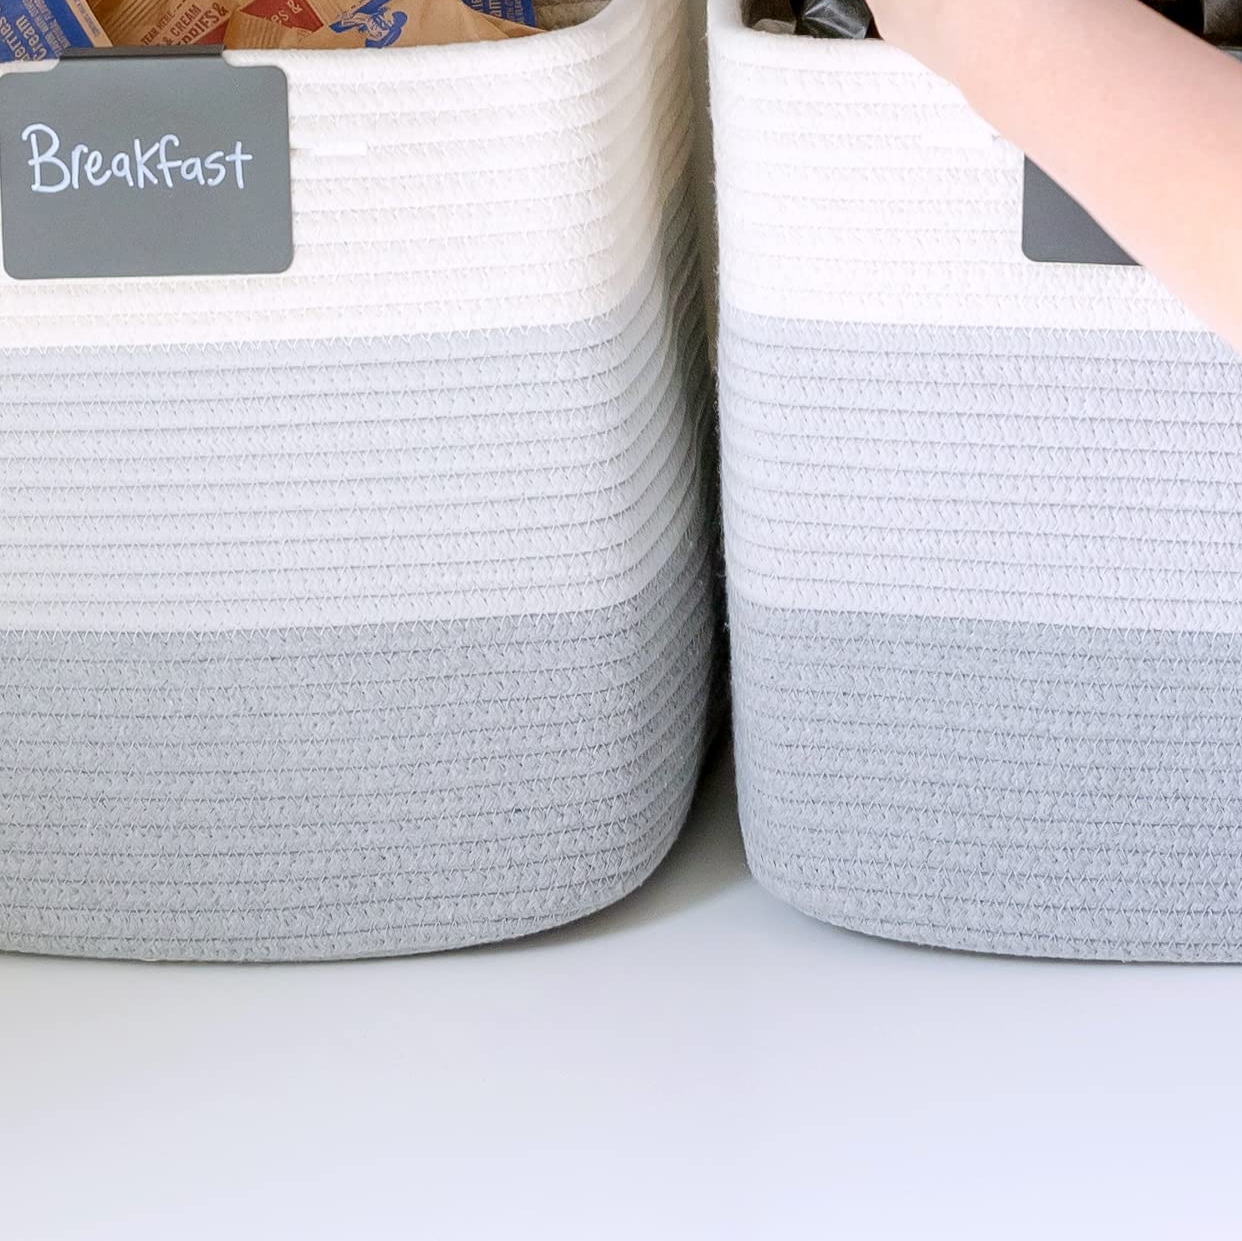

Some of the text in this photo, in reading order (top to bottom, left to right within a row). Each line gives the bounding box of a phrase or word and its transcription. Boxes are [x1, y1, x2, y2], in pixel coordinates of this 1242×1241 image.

[16, 15, 48, 61] Cream
[170, 4, 201, 37] CREAM
[21, 123, 253, 193] Breakfast
